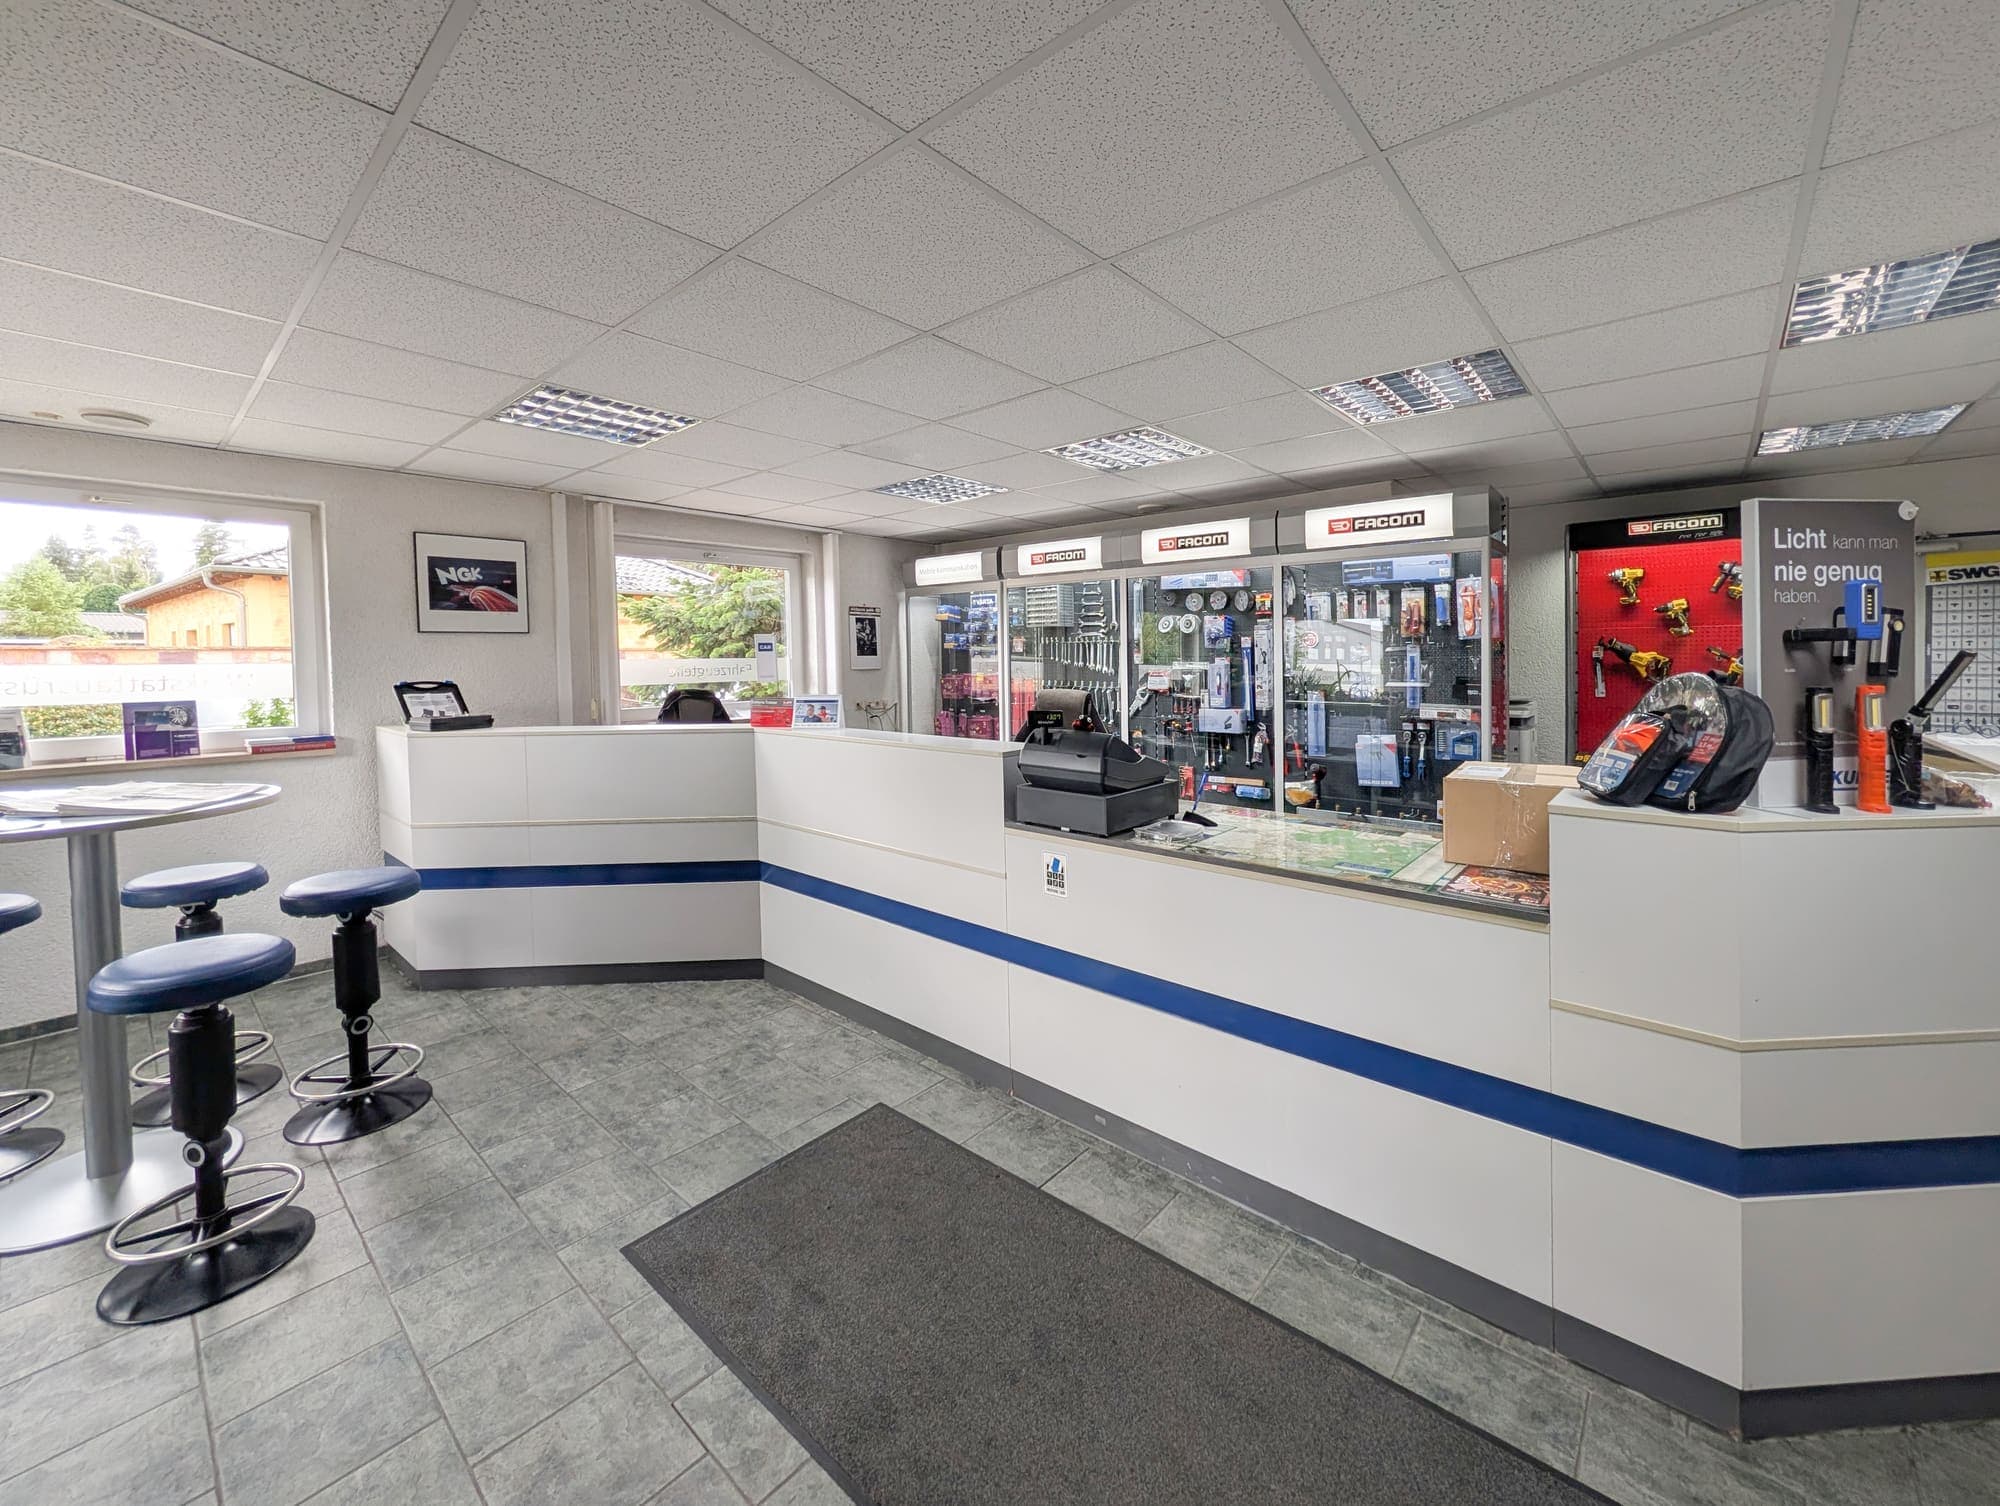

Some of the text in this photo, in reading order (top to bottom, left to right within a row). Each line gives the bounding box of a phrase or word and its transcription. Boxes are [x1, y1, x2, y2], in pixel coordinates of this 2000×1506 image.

[1354, 513, 1422, 530] FACOM
[1653, 516, 1720, 531] FACOM
[1178, 534, 1227, 548] FACOM
[1774, 527, 1898, 549] Licht kann man
[1045, 550, 1085, 562] FACOM
[435, 567, 484, 585] NGK
[1774, 560, 1807, 581] nie
[1948, 565, 2000, 581] SWG
[1774, 588, 1820, 603] haben.
